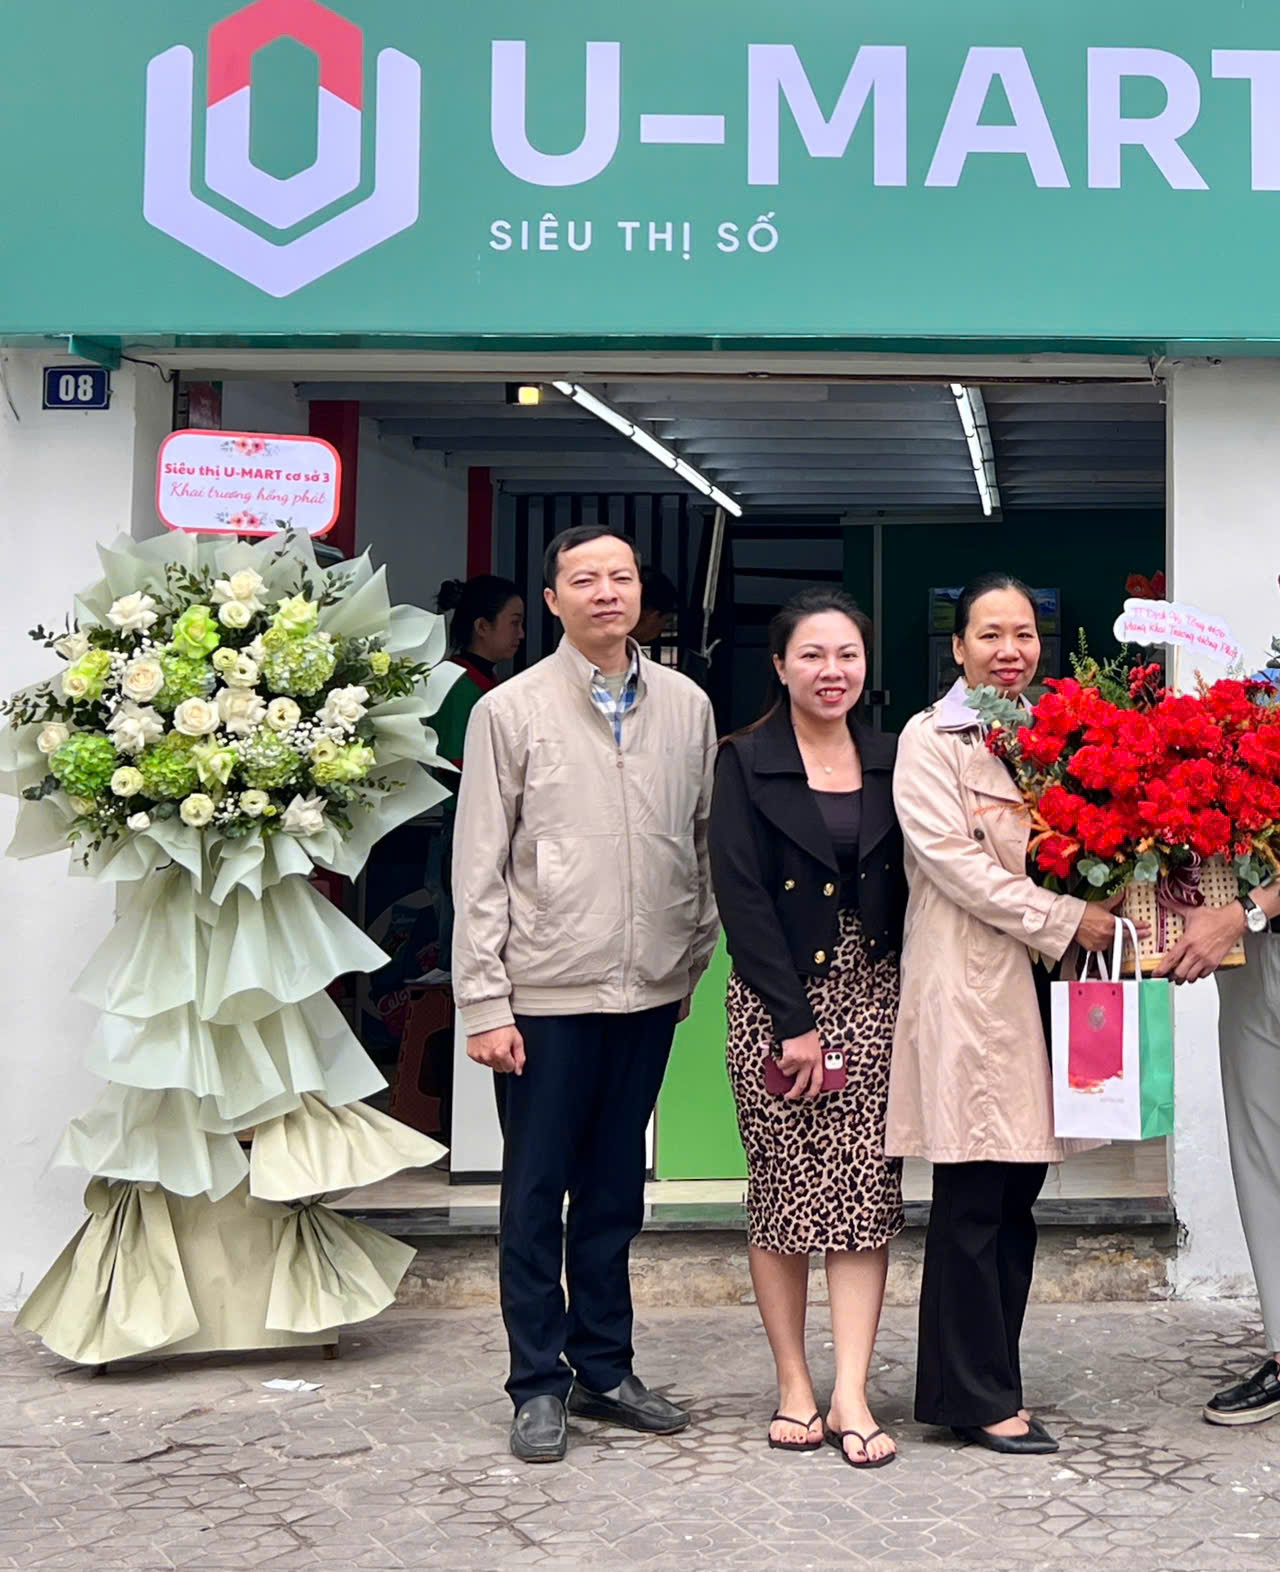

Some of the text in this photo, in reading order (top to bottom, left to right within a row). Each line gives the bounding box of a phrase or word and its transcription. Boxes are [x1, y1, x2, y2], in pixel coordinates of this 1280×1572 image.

[489, 212, 780, 261] SIÊU THỊ SỐ
[58, 373, 93, 402] 08
[164, 462, 331, 483] Siêu thị U-MART cơ sở 3
[169, 481, 204, 498] Khai
[207, 485, 252, 502] trương
[292, 489, 327, 506] phát
